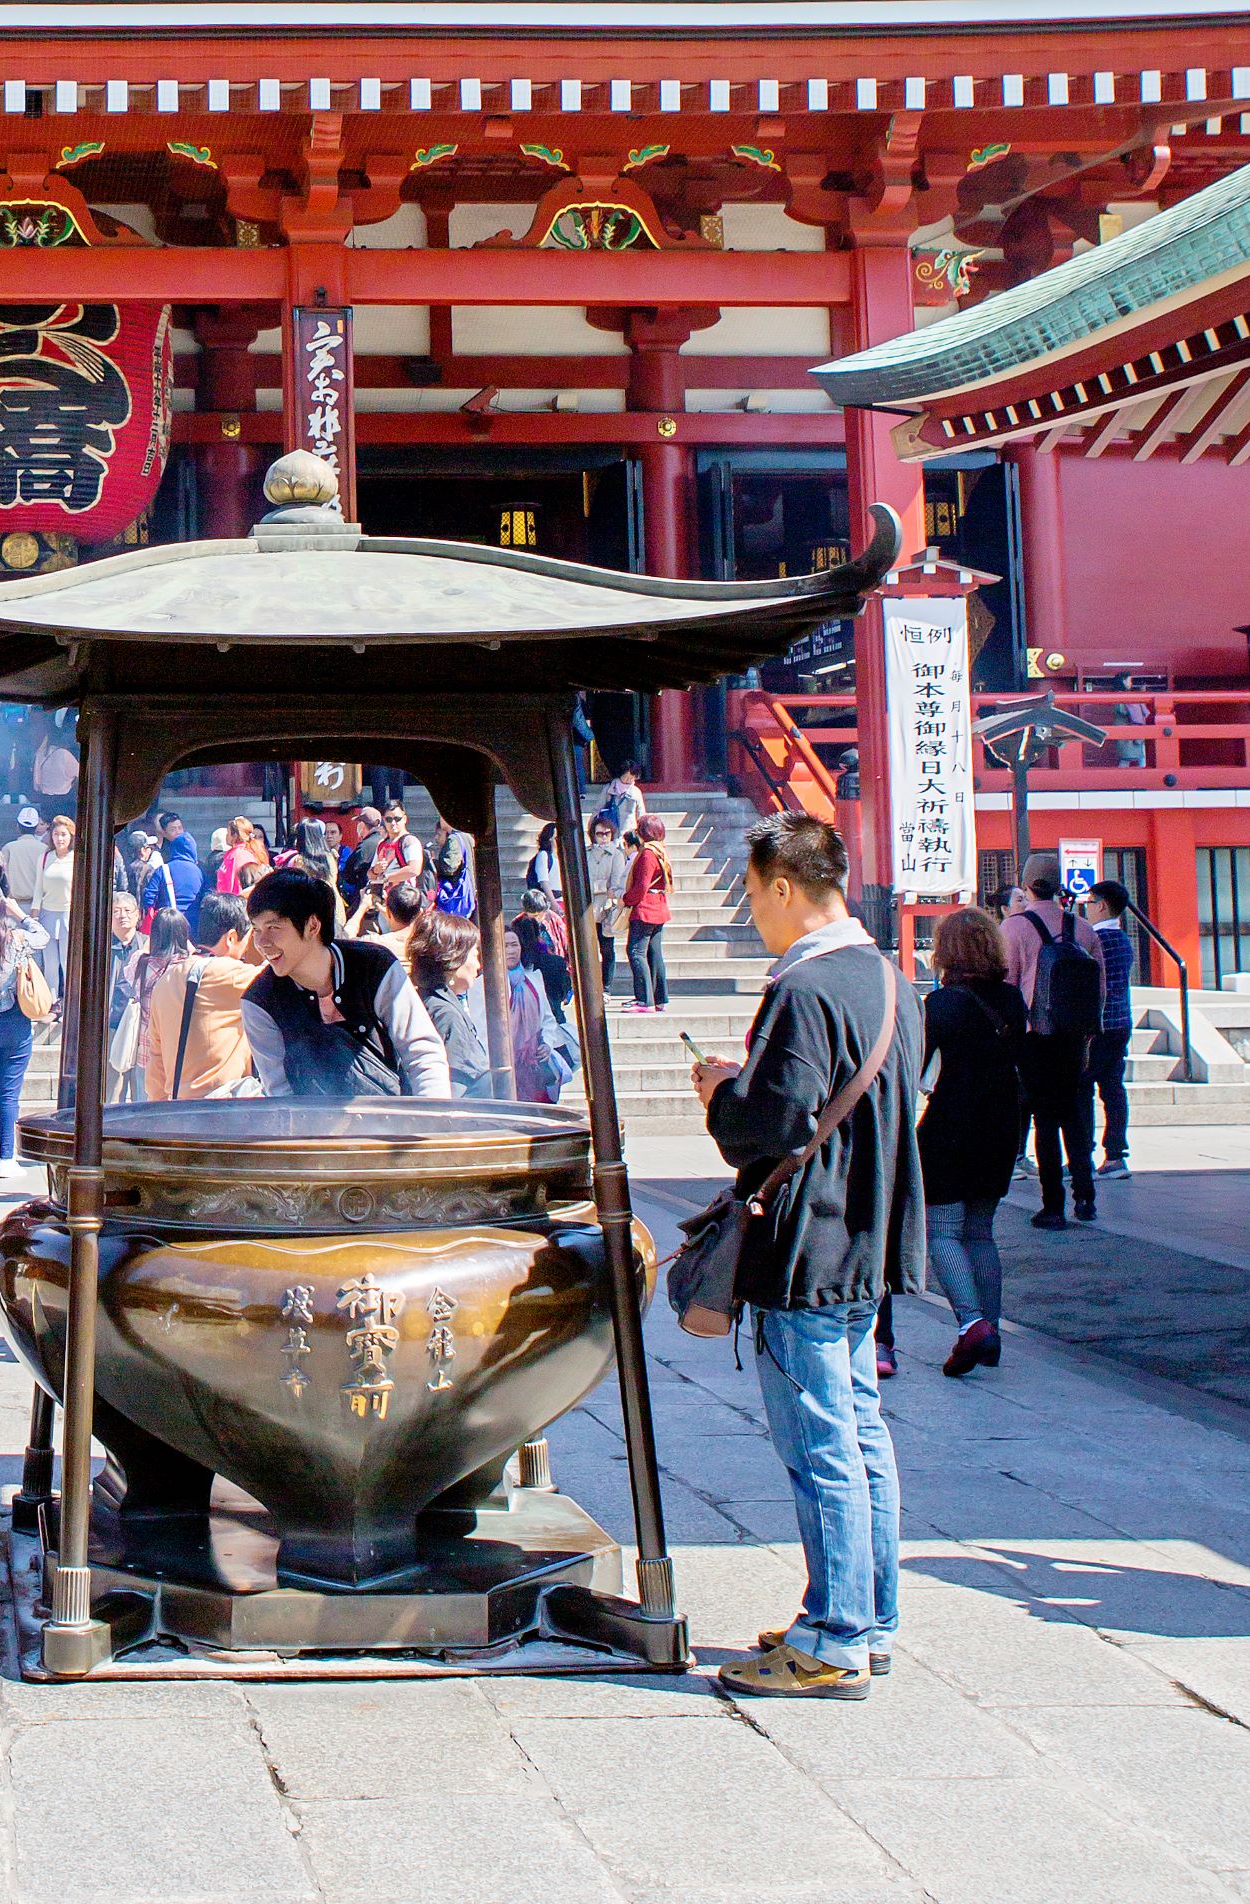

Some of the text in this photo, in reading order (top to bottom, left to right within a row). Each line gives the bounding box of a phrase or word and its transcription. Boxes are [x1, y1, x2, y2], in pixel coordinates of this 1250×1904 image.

[900, 625, 952, 644] 恒例
[950, 669, 966, 804] 毎月十八日
[899, 821, 917, 872] 當山
